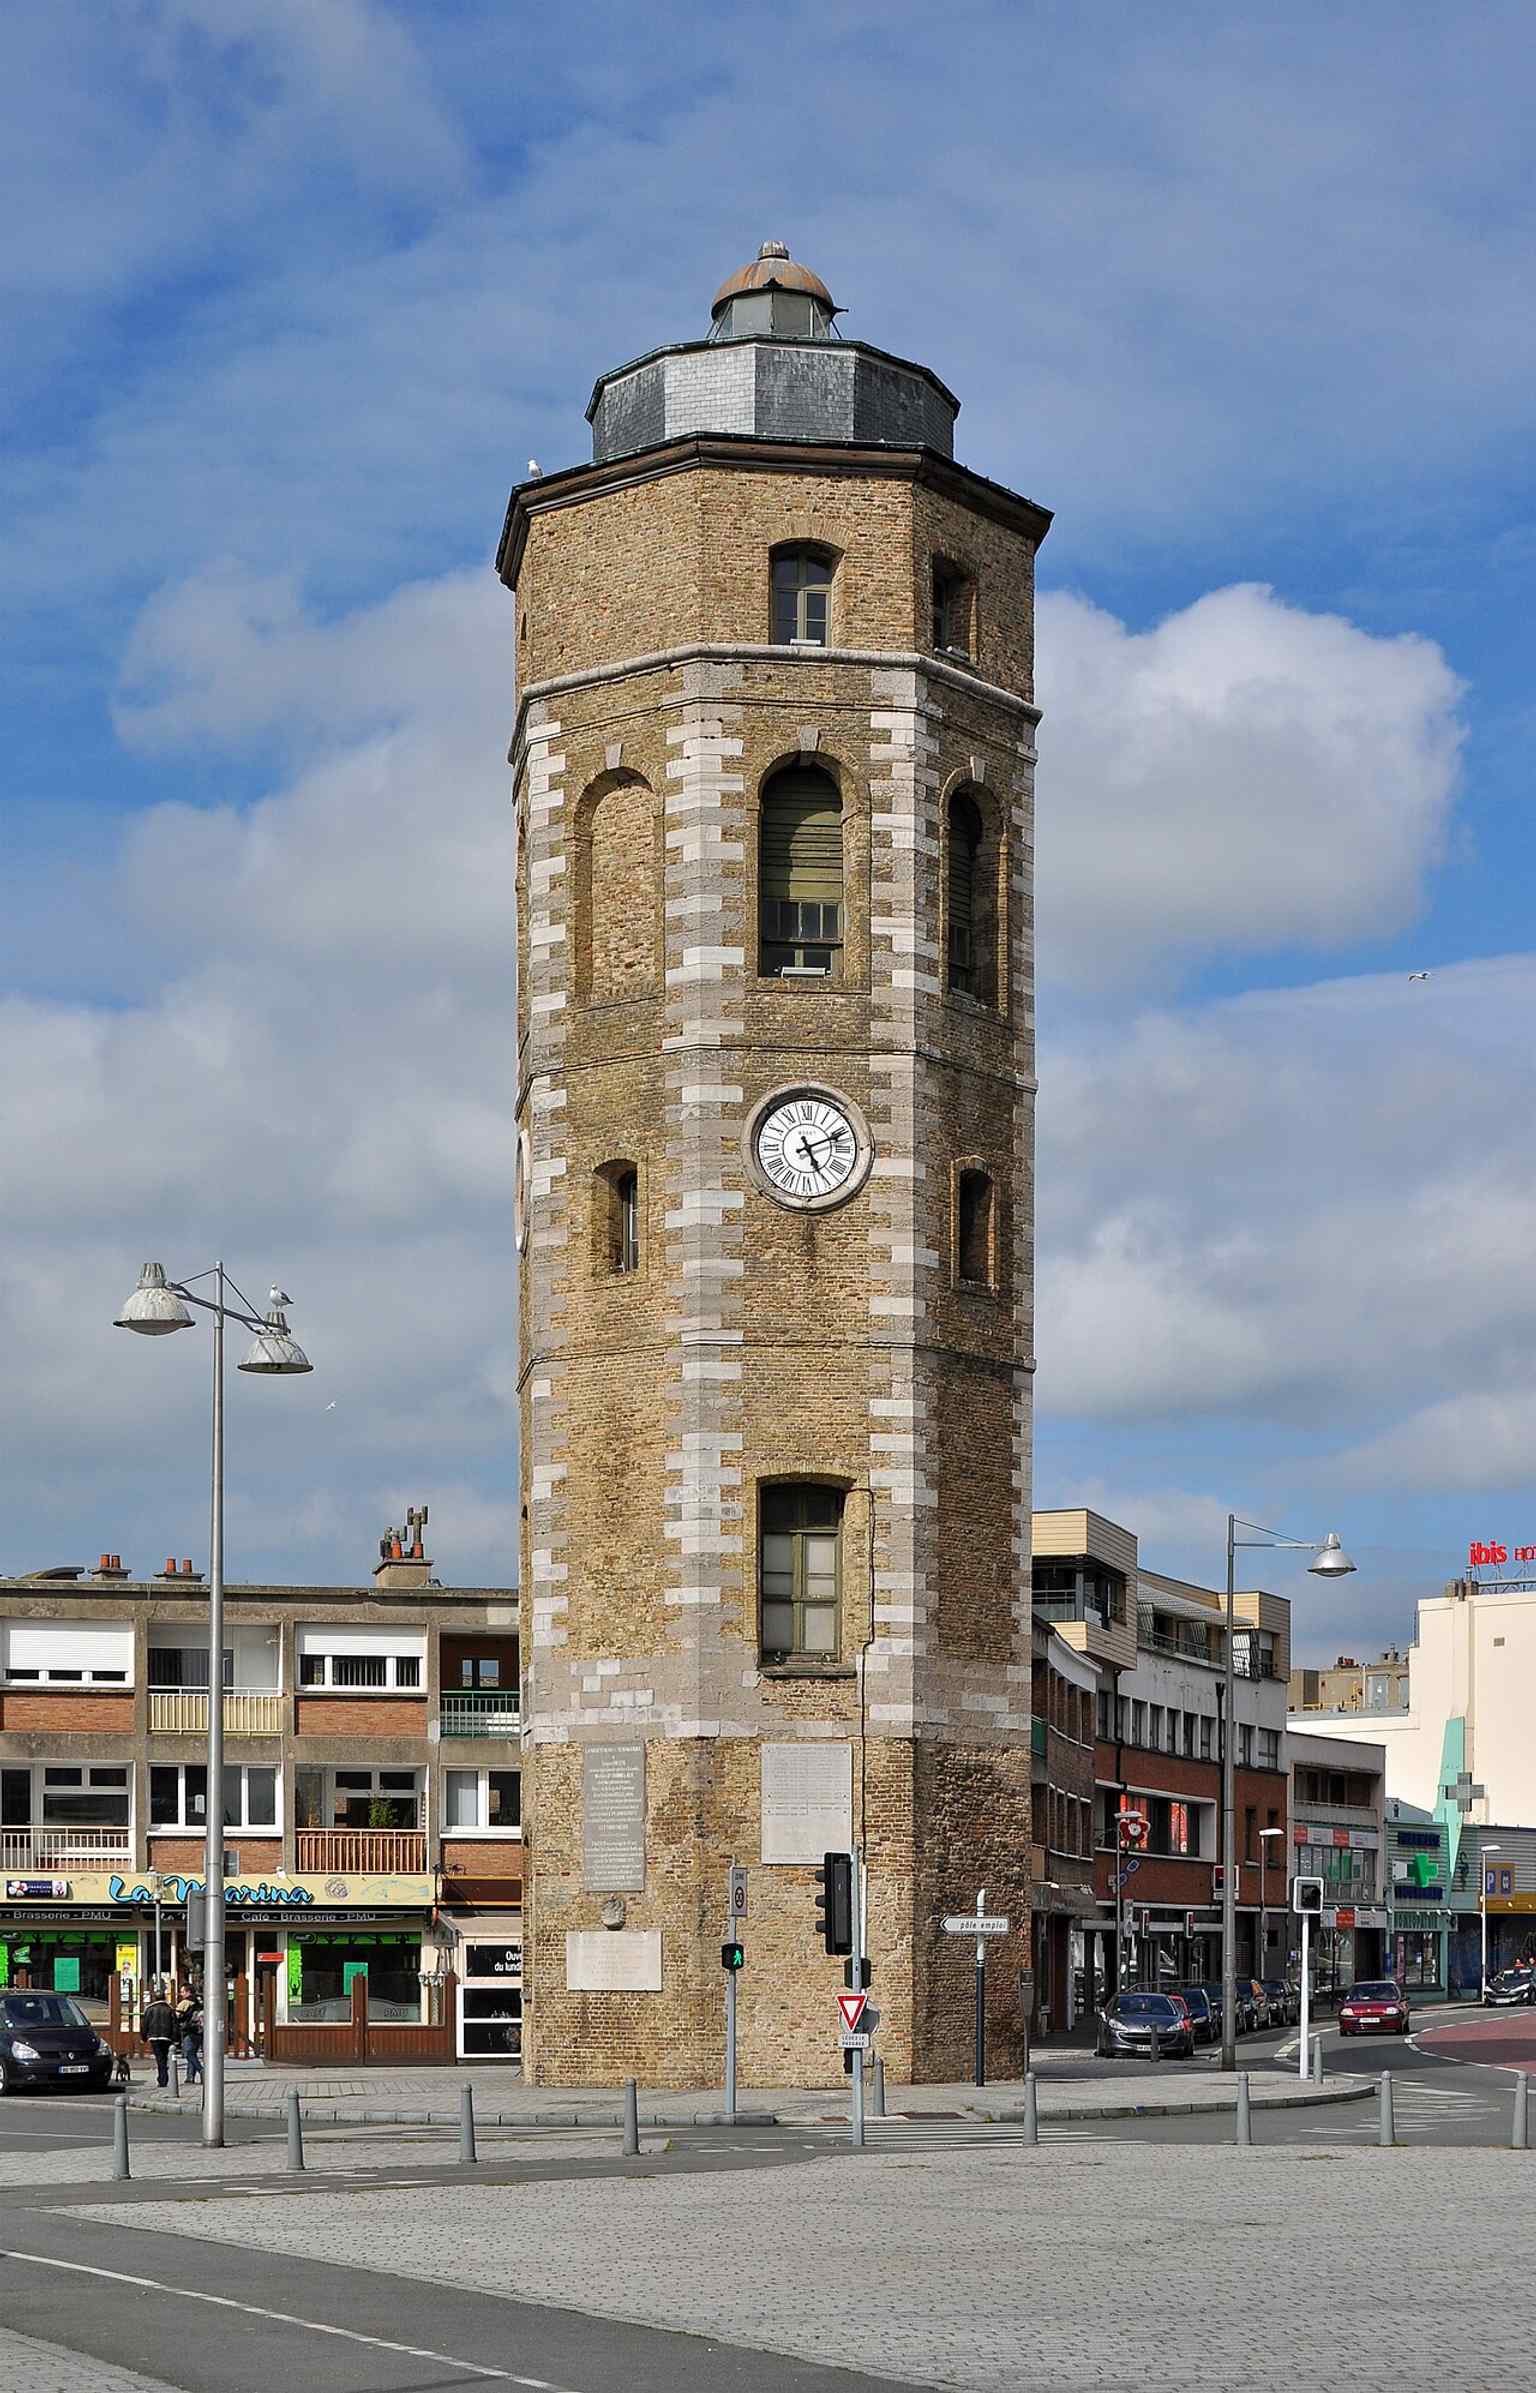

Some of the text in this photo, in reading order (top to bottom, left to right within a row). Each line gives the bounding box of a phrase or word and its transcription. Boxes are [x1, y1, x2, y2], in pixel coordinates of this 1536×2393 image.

[1470, 1540, 1536, 1565] ibis HO
[109, 1875, 154, 1903] La
[13, 1910, 112, 1920] Brasserie PMU
[241, 1912, 377, 1921] Café Brasserie PMU
[980, 1920, 1006, 1930] emploi
[494, 1962, 504, 1972] du
